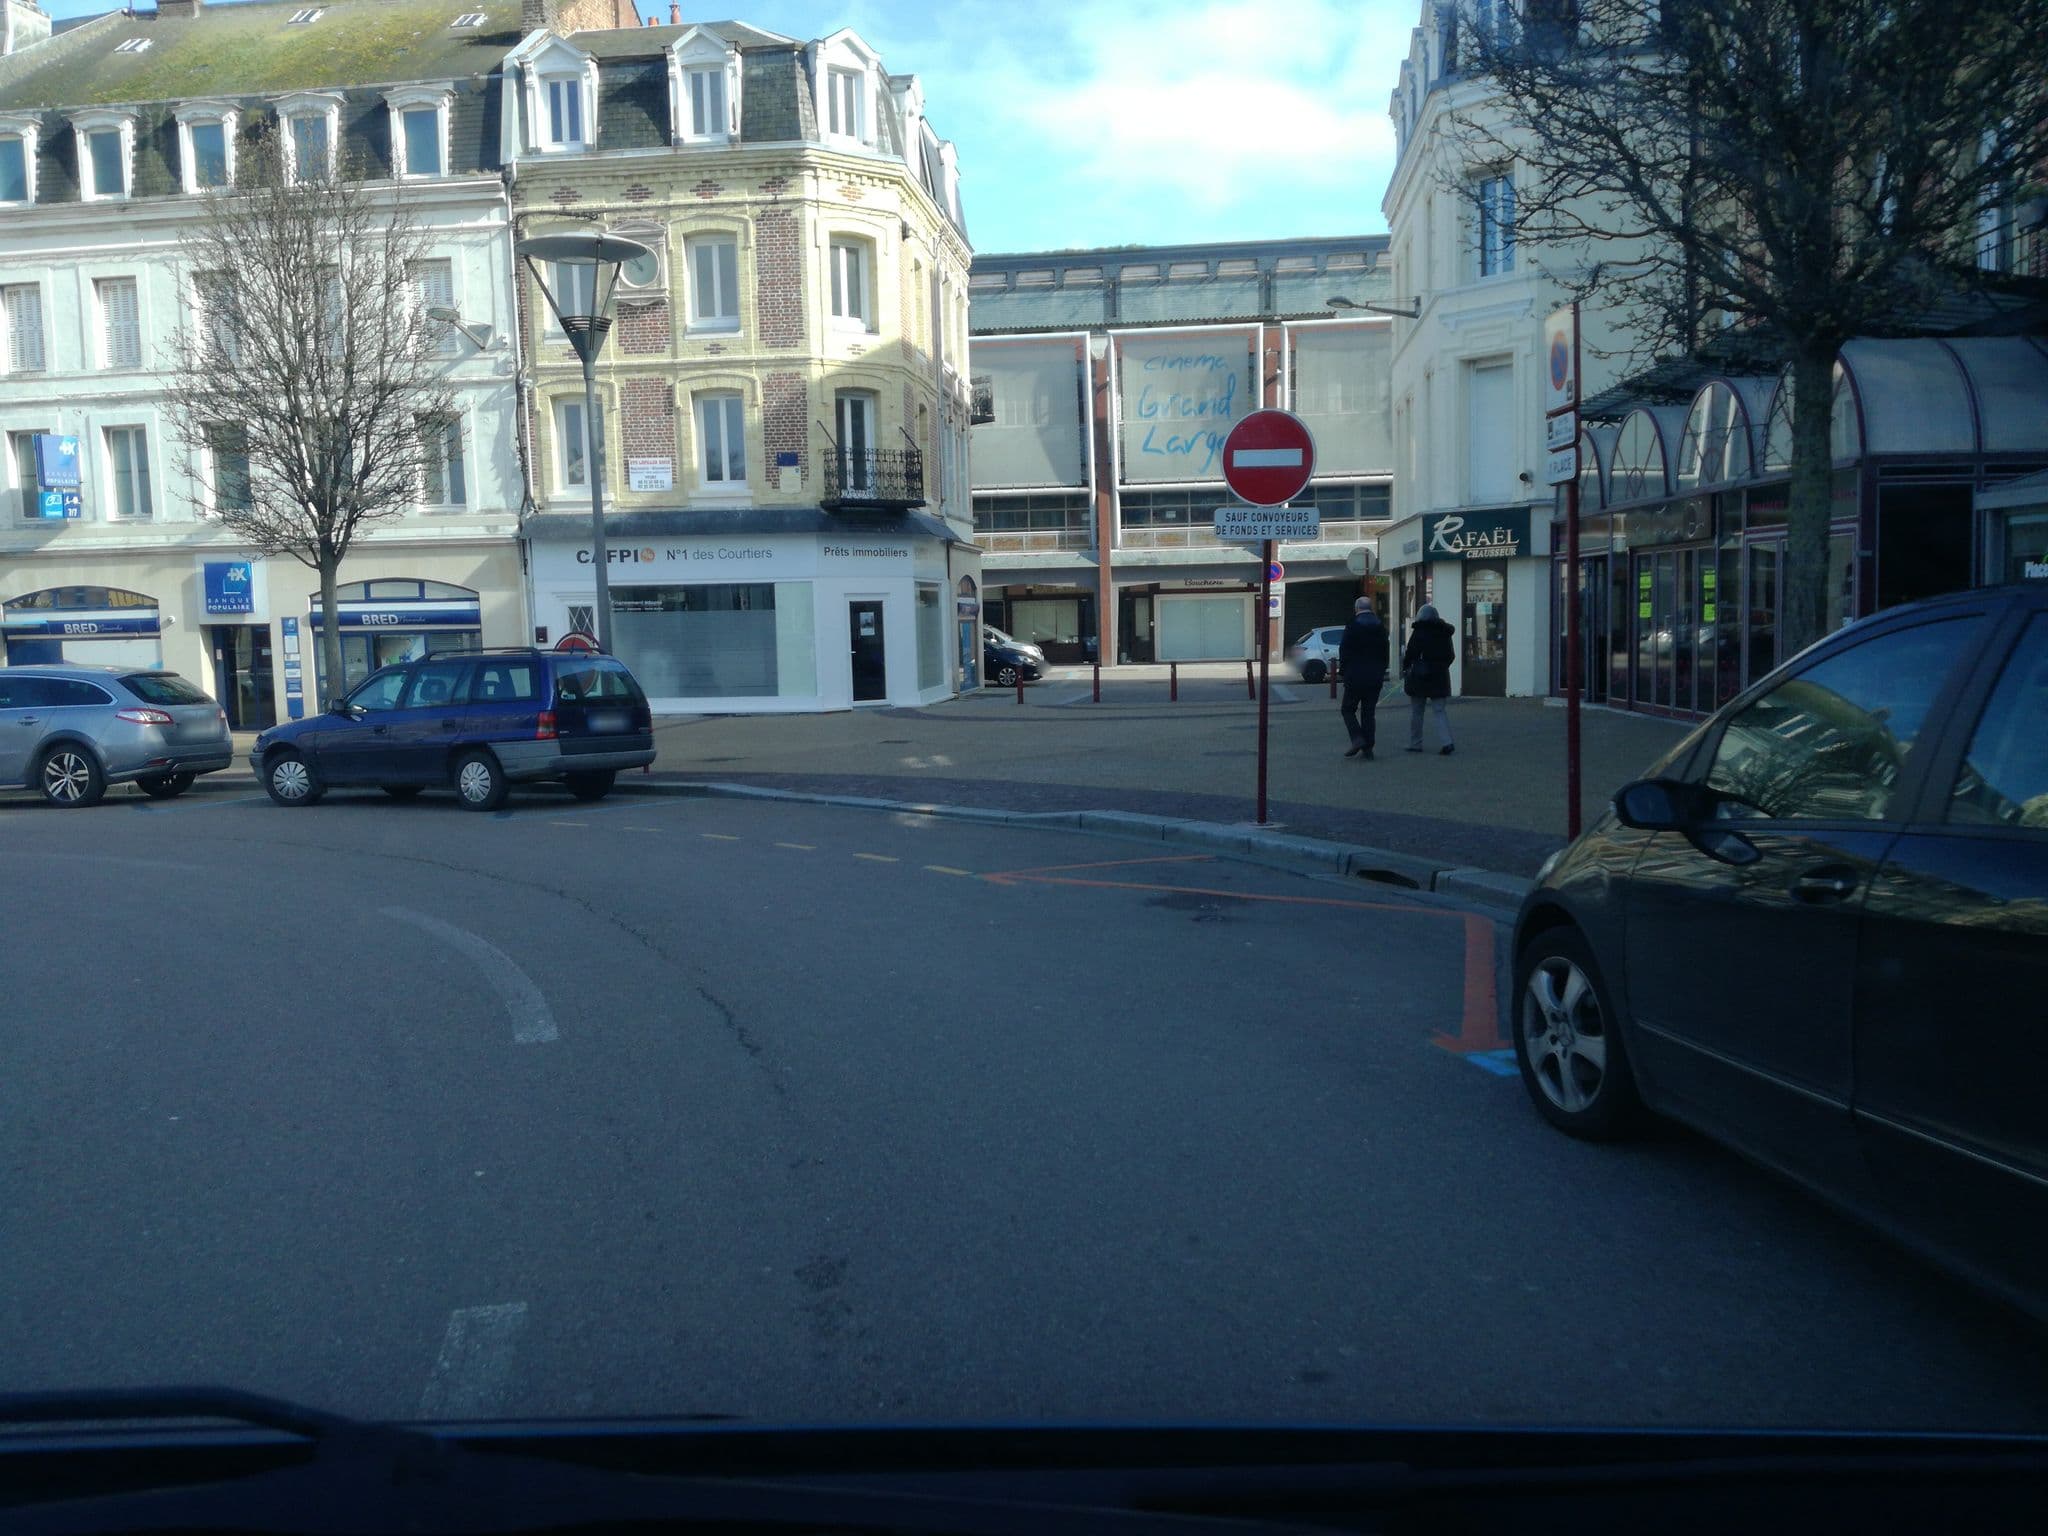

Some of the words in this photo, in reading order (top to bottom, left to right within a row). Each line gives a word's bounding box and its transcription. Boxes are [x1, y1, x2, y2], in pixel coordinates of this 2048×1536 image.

[1138, 373, 1236, 418] Grand
[1225, 512, 1248, 522] SAUF
[1250, 512, 1310, 522] CONVOYEURS
[1215, 525, 1226, 535] DE
[1230, 525, 1258, 536] FONDS
[1261, 525, 1272, 535] ET
[1275, 525, 1318, 536] SERVICES
[576, 549, 639, 564] CFPI
[692, 548, 714, 561] des
[718, 548, 773, 560] Courtiers
[852, 547, 909, 558] immobiliers
[1466, 547, 1517, 559] CHAUSSEUR
[361, 614, 399, 625] BRED
[64, 623, 98, 634] BRED
